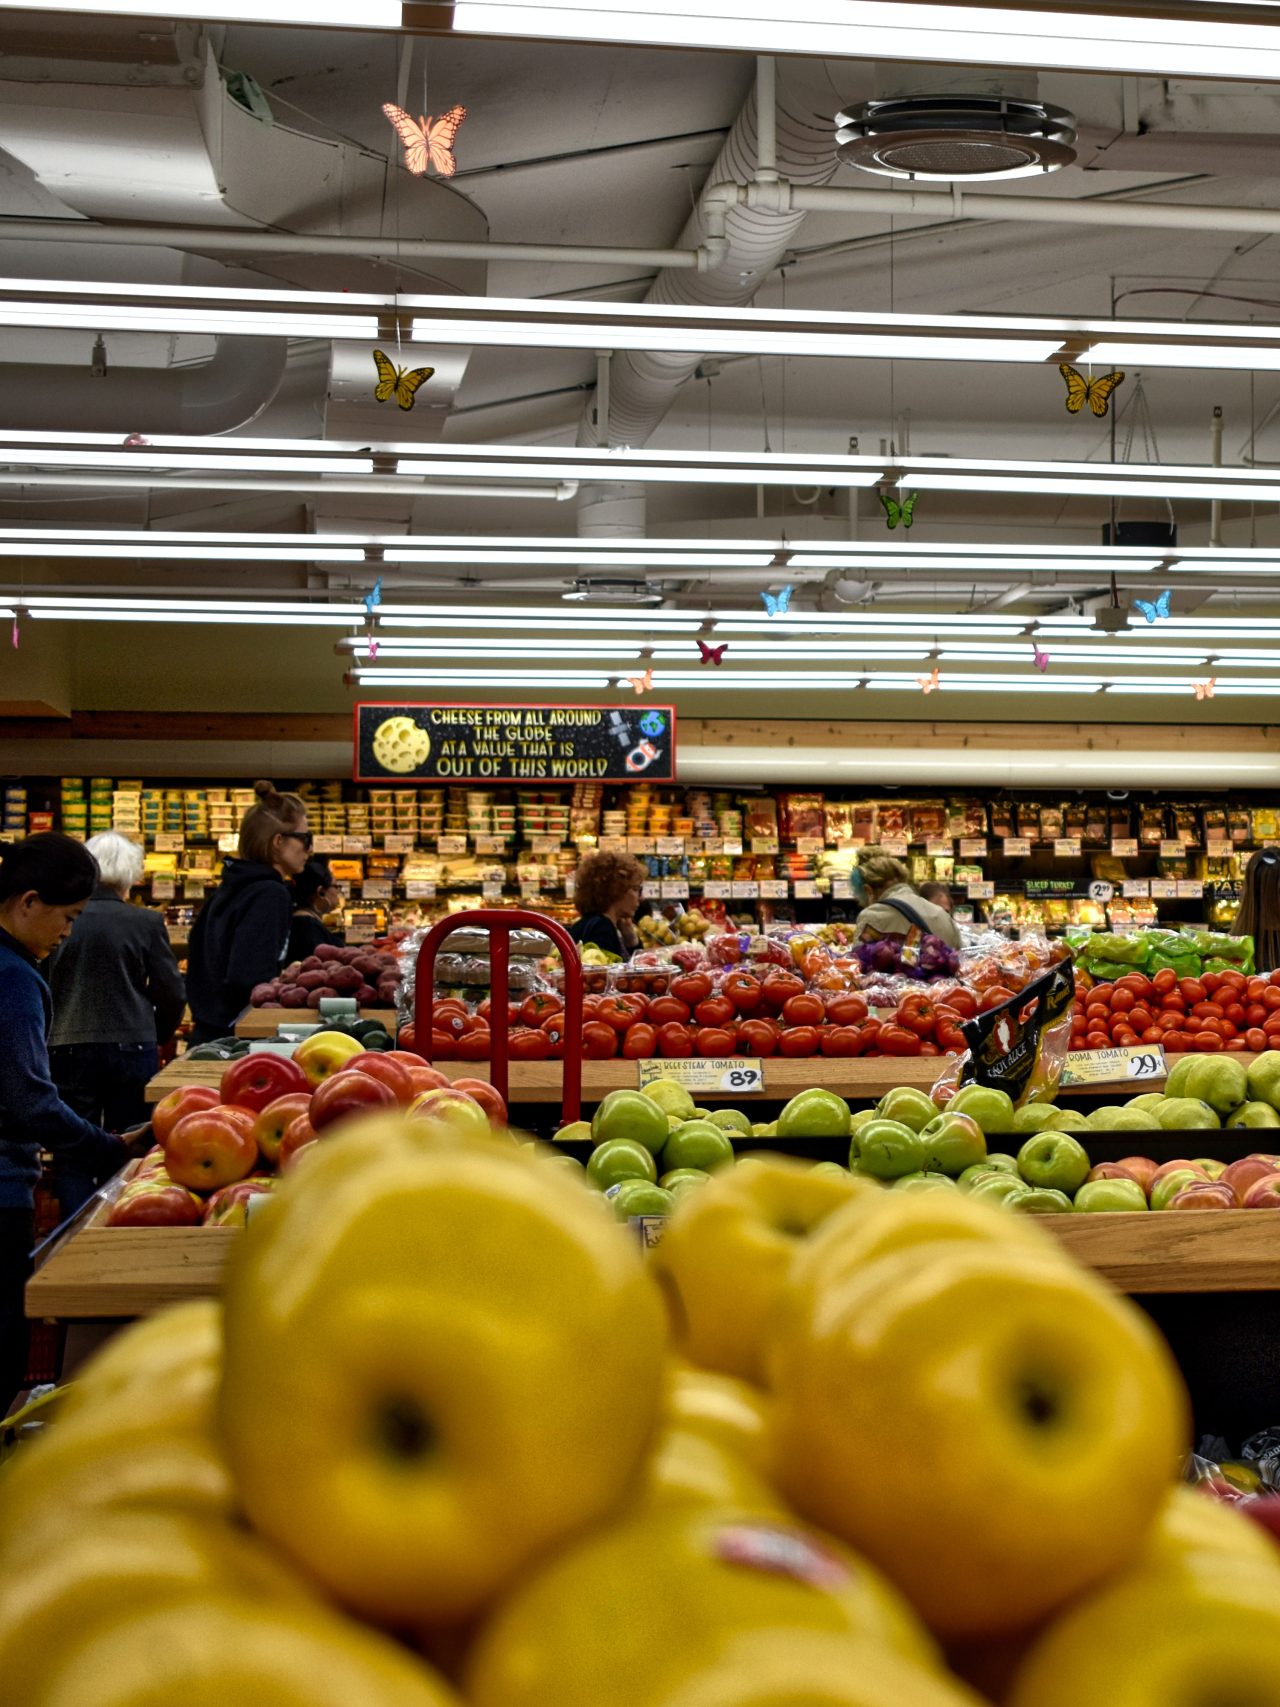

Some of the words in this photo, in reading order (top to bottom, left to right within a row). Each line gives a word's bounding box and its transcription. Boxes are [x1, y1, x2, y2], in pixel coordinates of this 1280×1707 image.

[430, 709, 483, 726] CHEESE
[486, 710, 522, 726] FROM
[525, 710, 546, 726] ALL
[549, 711, 602, 726] AROUND
[475, 726, 500, 741] THE
[505, 726, 553, 741] GLOBE
[473, 741, 516, 757] VALUE
[519, 741, 557, 757] THAT
[559, 741, 574, 757] IS
[436, 757, 474, 776] OUT
[479, 757, 502, 775] OF
[507, 758, 547, 777] THIS
[551, 758, 609, 777] WORLD
[1050, 880, 1075, 889] TURKEY
[1068, 1052, 1092, 1062] ROMA
[1096, 1049, 1129, 1060] TOMATO
[711, 1061, 745, 1070] TOMATO
